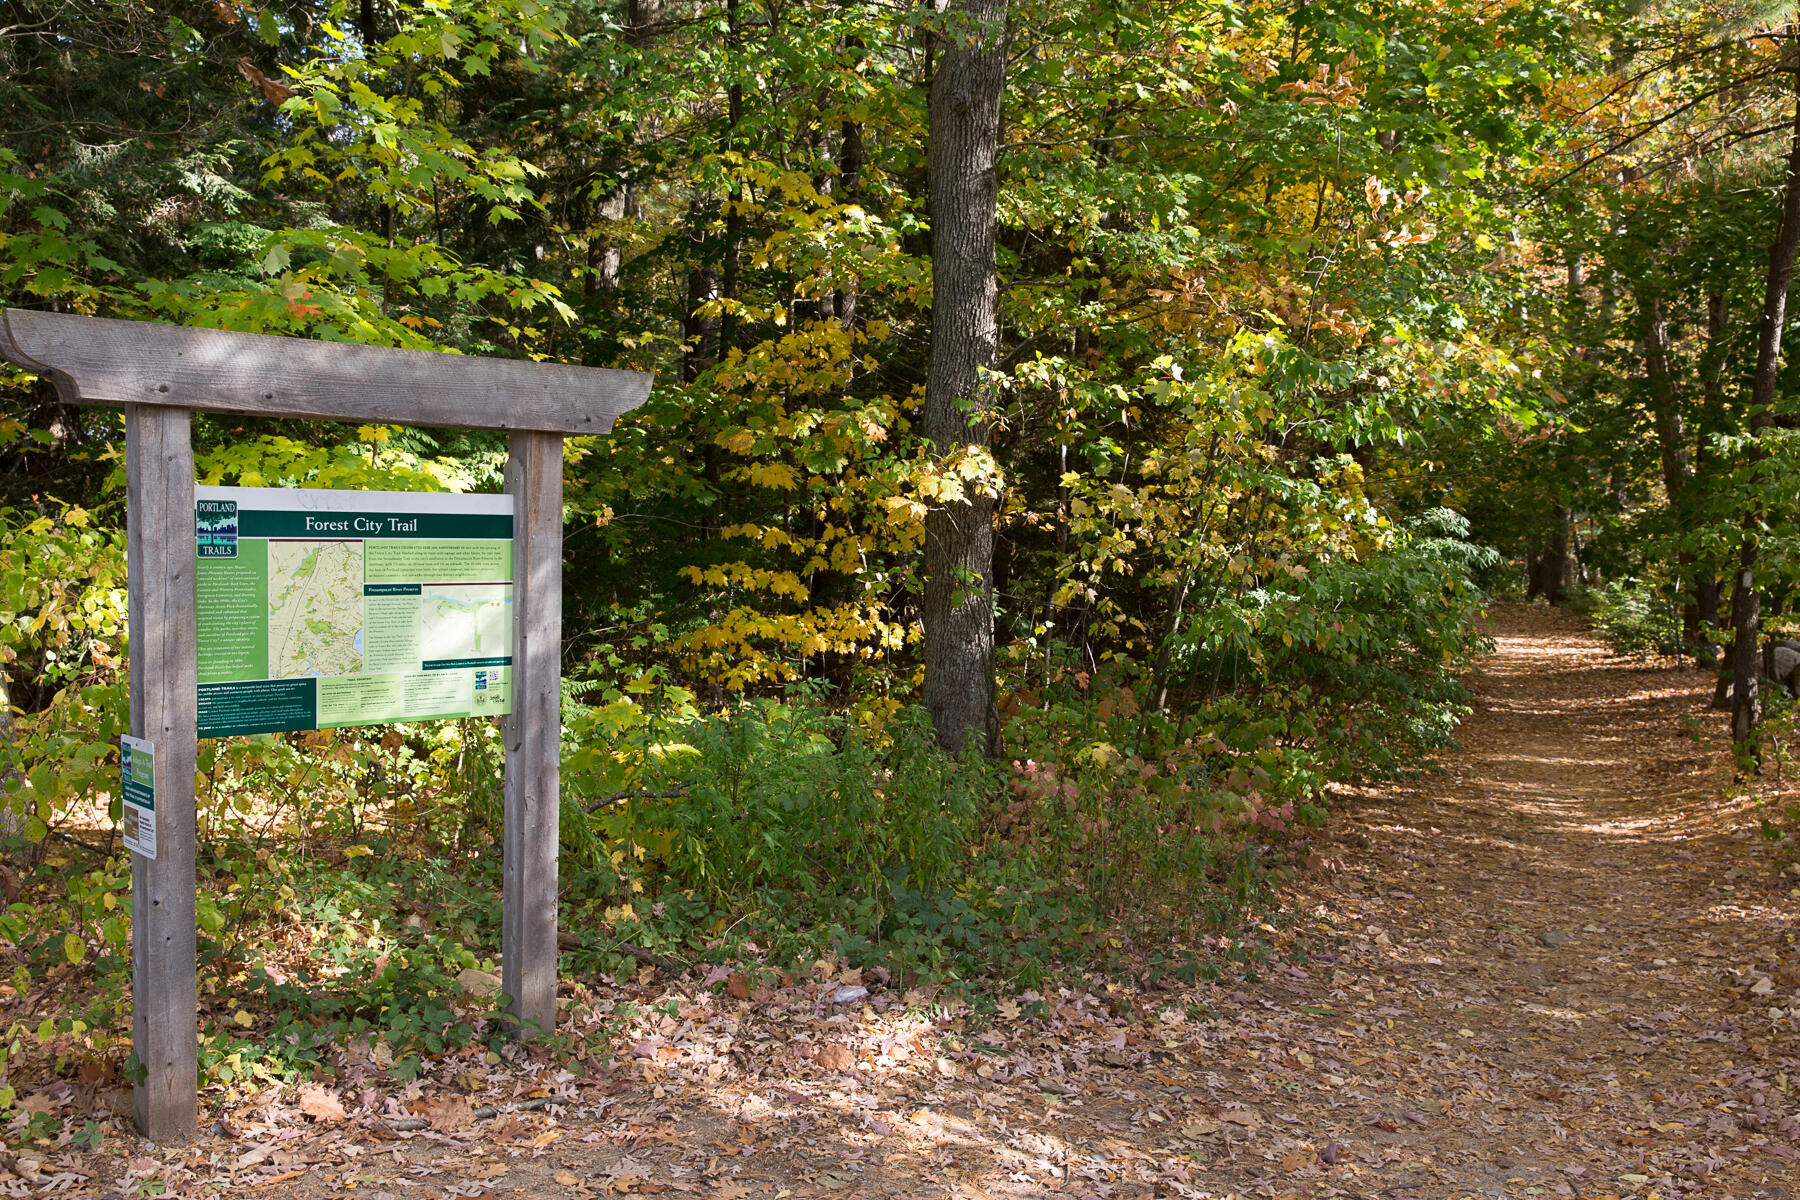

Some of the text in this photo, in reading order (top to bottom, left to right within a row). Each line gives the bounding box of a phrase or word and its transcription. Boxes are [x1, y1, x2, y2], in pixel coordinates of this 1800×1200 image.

[199, 502, 236, 512] PORTLAND
[305, 516, 418, 534] Forest City Trail
[203, 546, 232, 555] TRAILS
